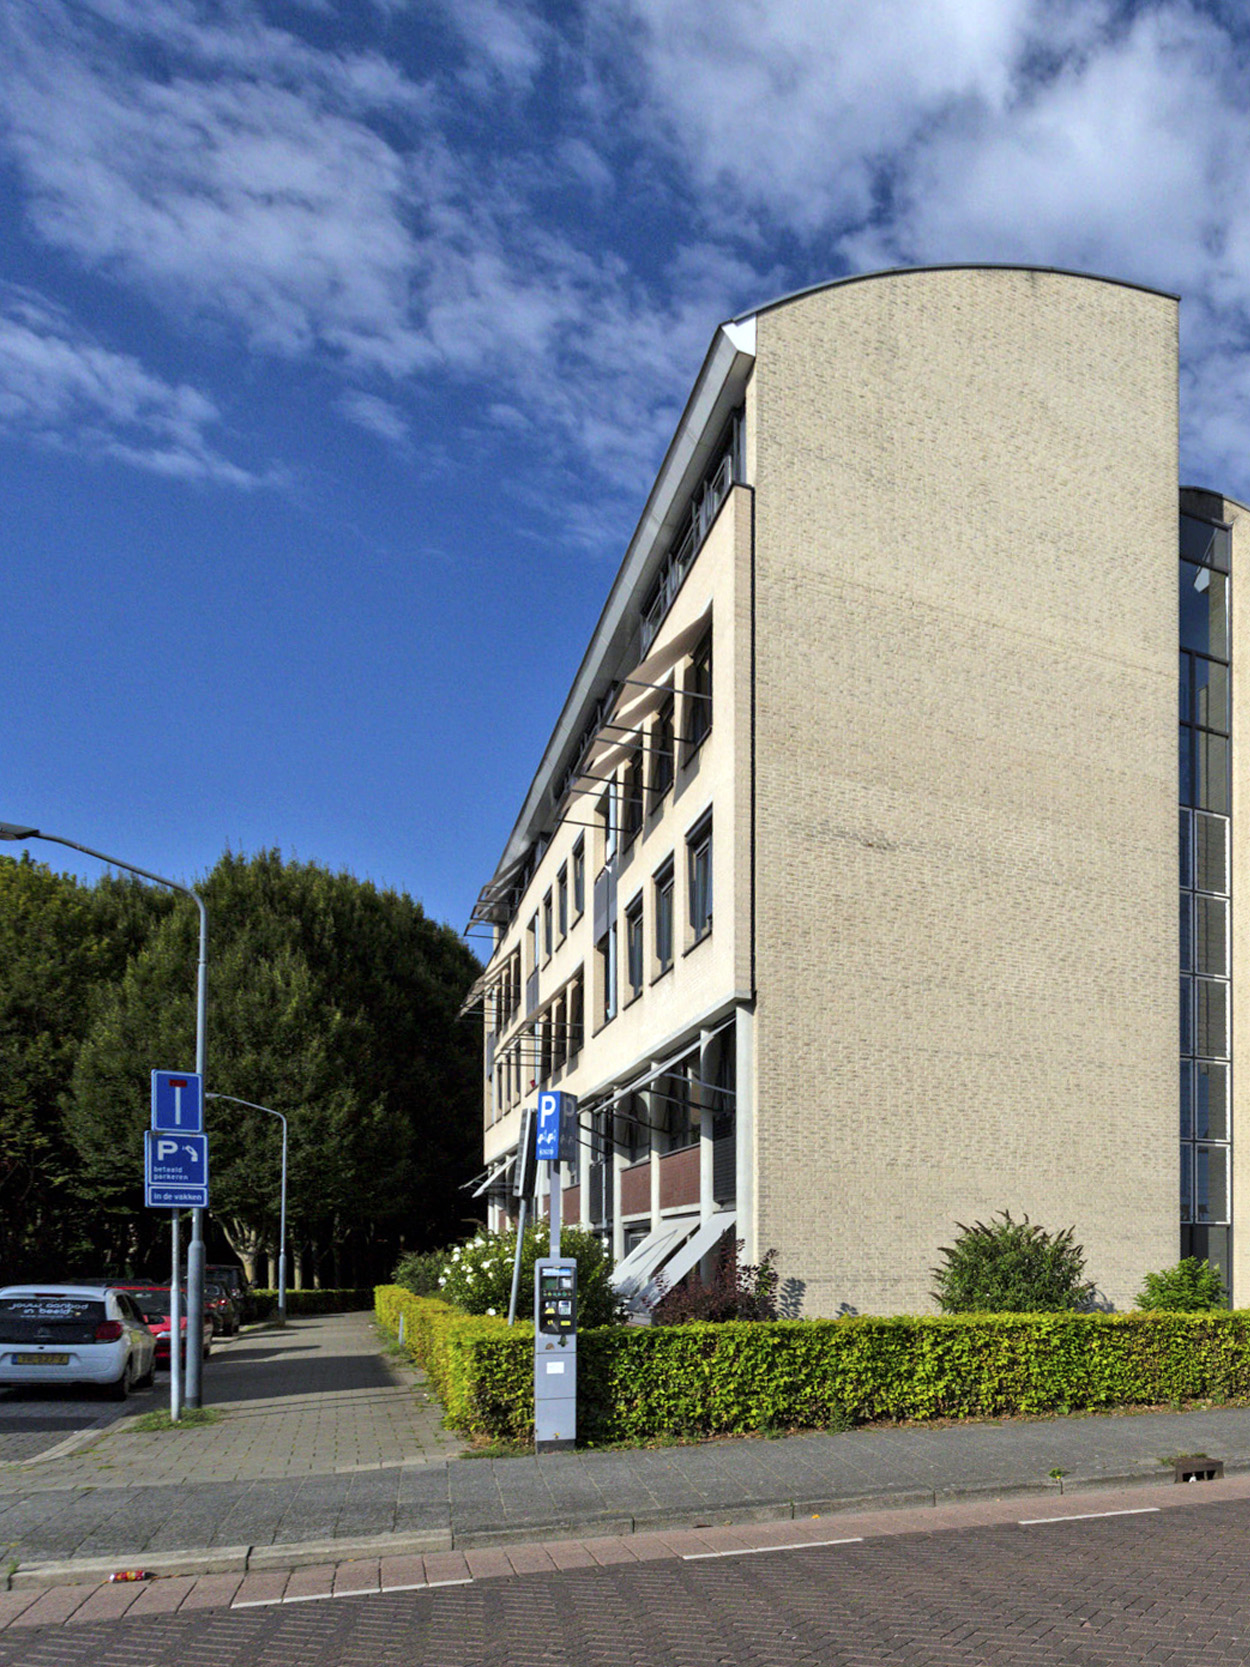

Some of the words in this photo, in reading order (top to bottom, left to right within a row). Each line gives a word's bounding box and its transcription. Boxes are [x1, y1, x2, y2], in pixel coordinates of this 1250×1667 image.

[541, 1095, 556, 1128] P
[158, 1140, 178, 1161] P
[174, 1193, 202, 1201] vakken
